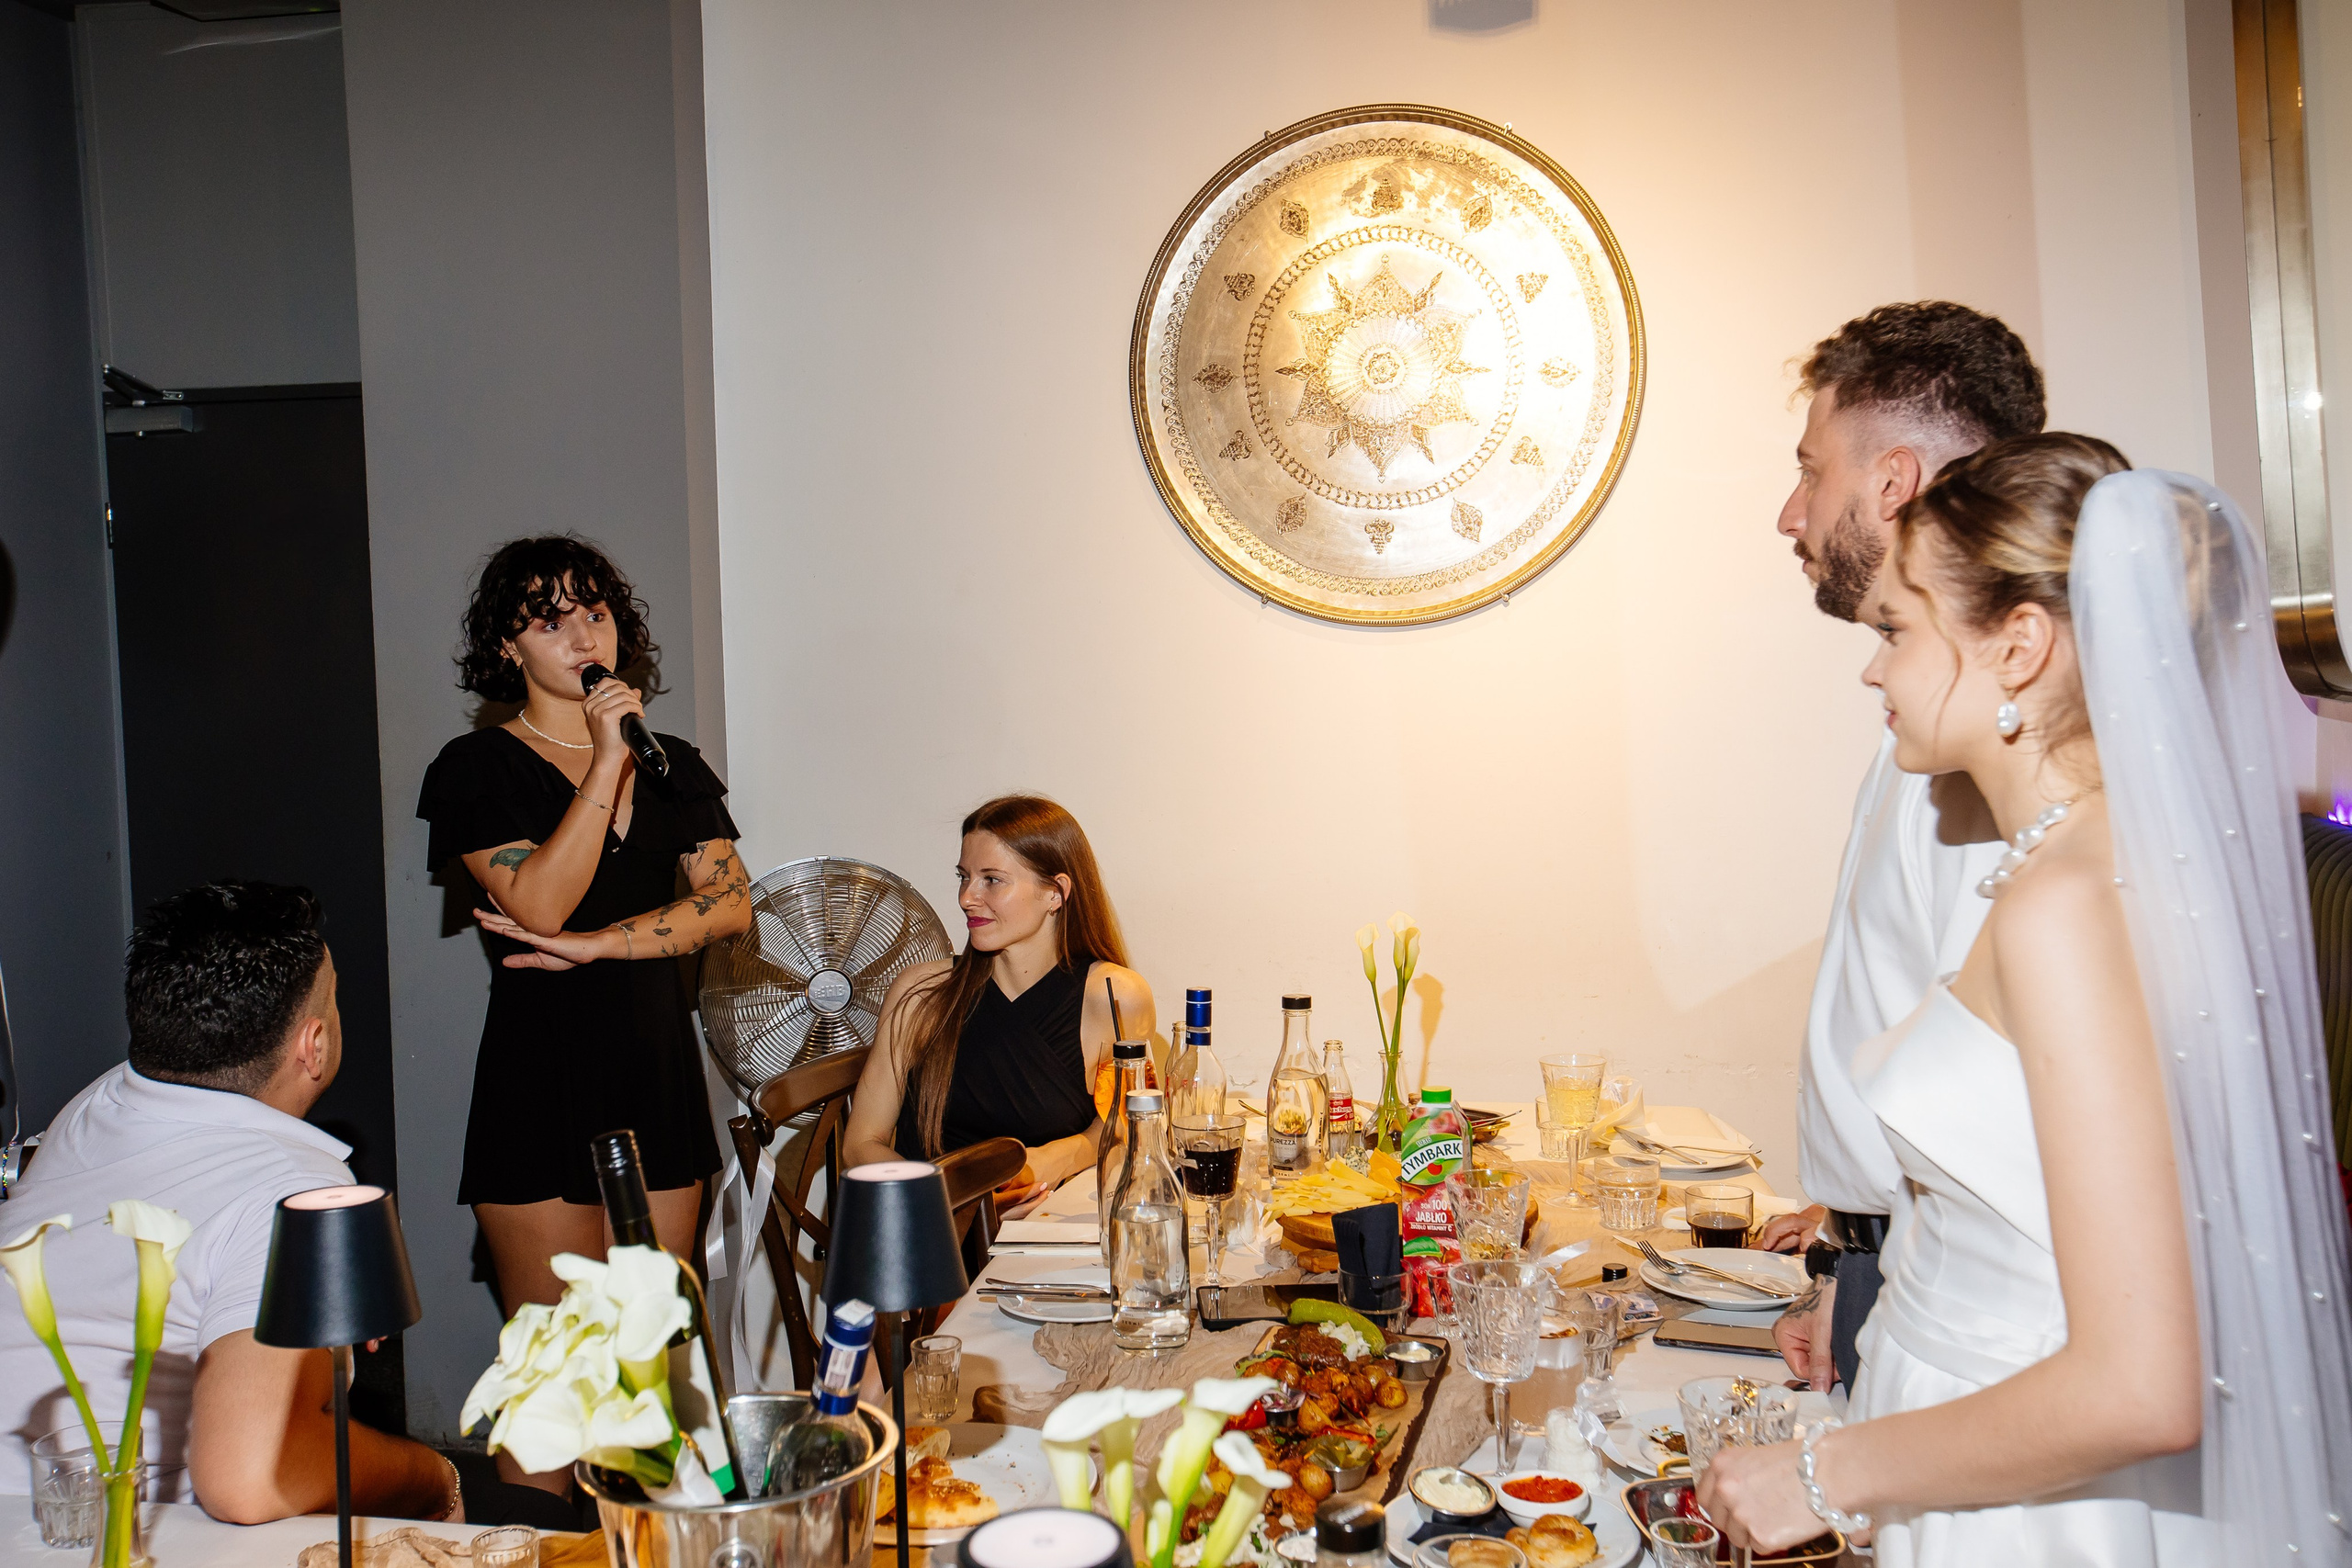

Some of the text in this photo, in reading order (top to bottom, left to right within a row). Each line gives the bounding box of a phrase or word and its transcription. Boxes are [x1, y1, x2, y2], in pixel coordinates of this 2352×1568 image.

[1270, 1137, 1296, 1145] PUREZZA
[1401, 1143, 1462, 1175] TYMBARK
[1415, 1212, 1447, 1224] JABŁKO
